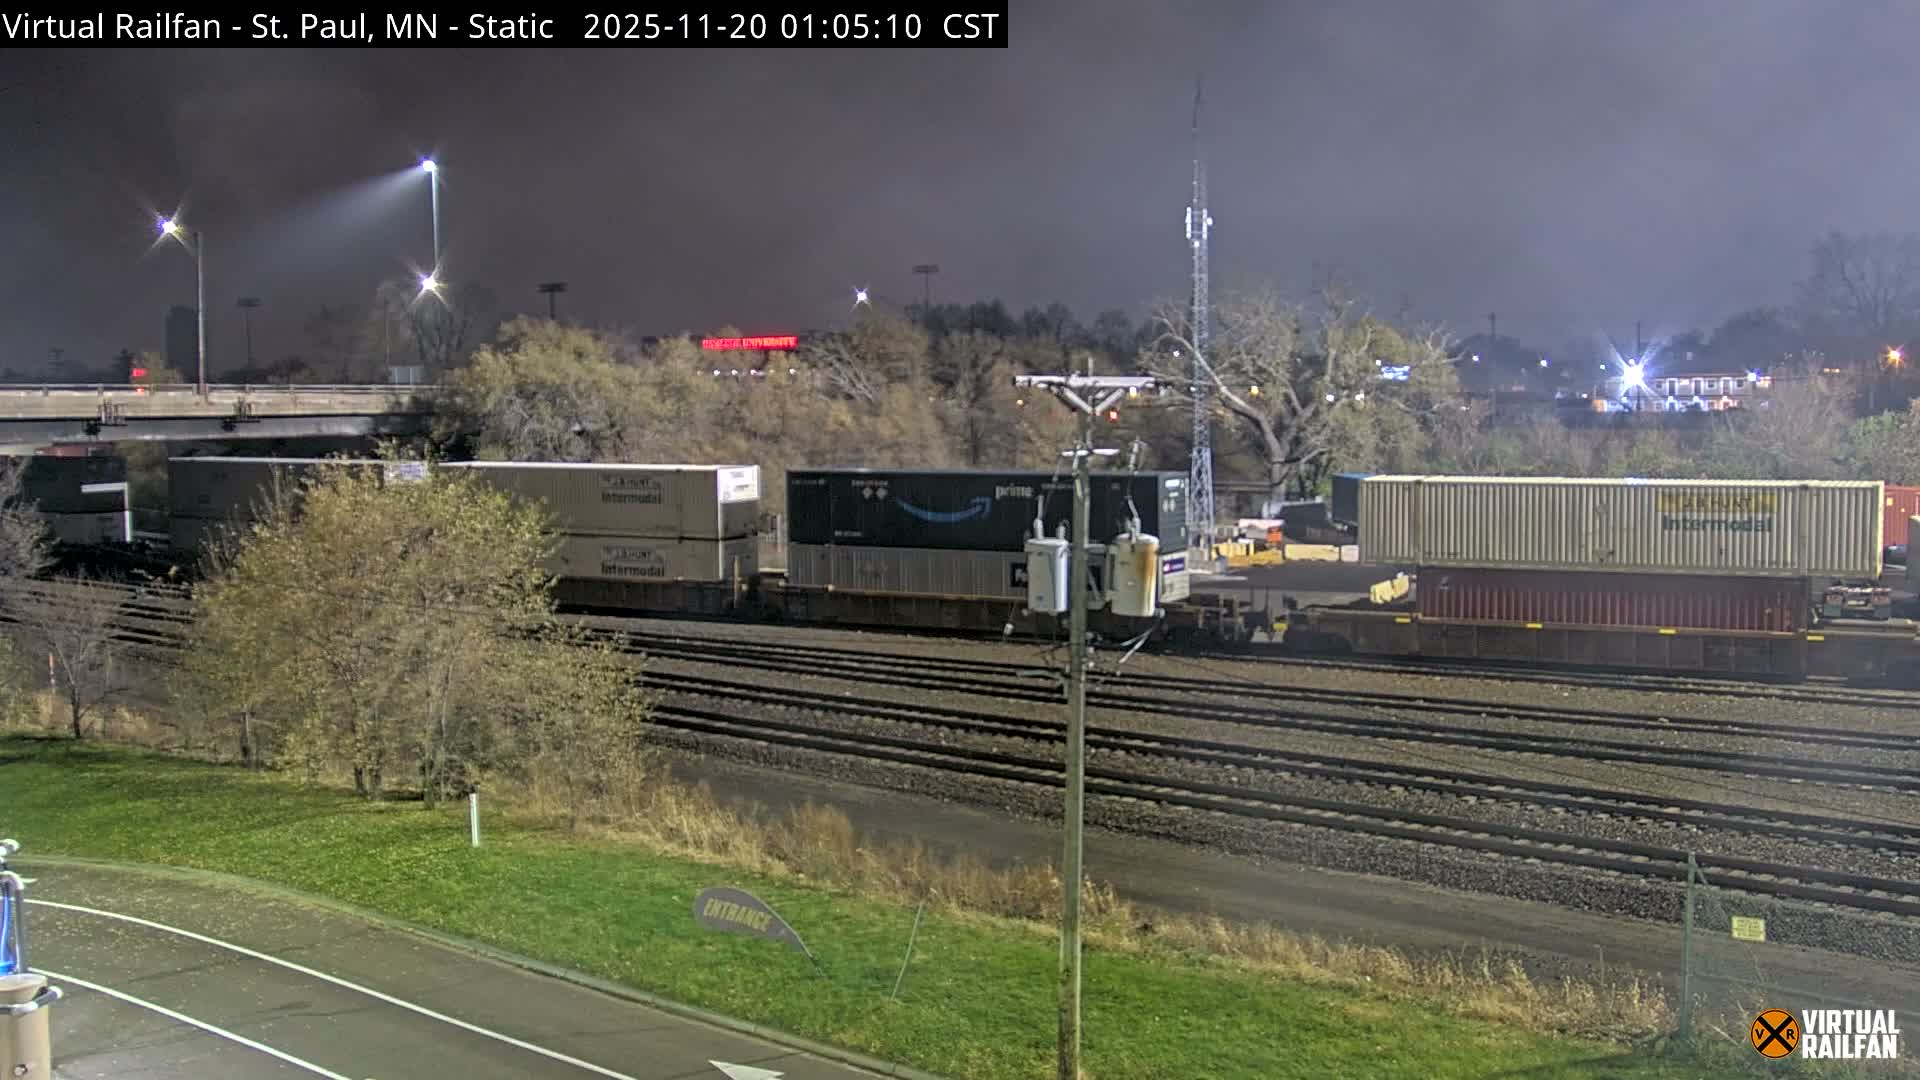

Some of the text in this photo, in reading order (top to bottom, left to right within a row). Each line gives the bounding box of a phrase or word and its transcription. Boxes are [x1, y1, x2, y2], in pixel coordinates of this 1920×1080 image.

[995, 485, 1034, 499] prime
[1663, 514, 1773, 533] Intermodal
[703, 897, 773, 933] ENTRANCE
